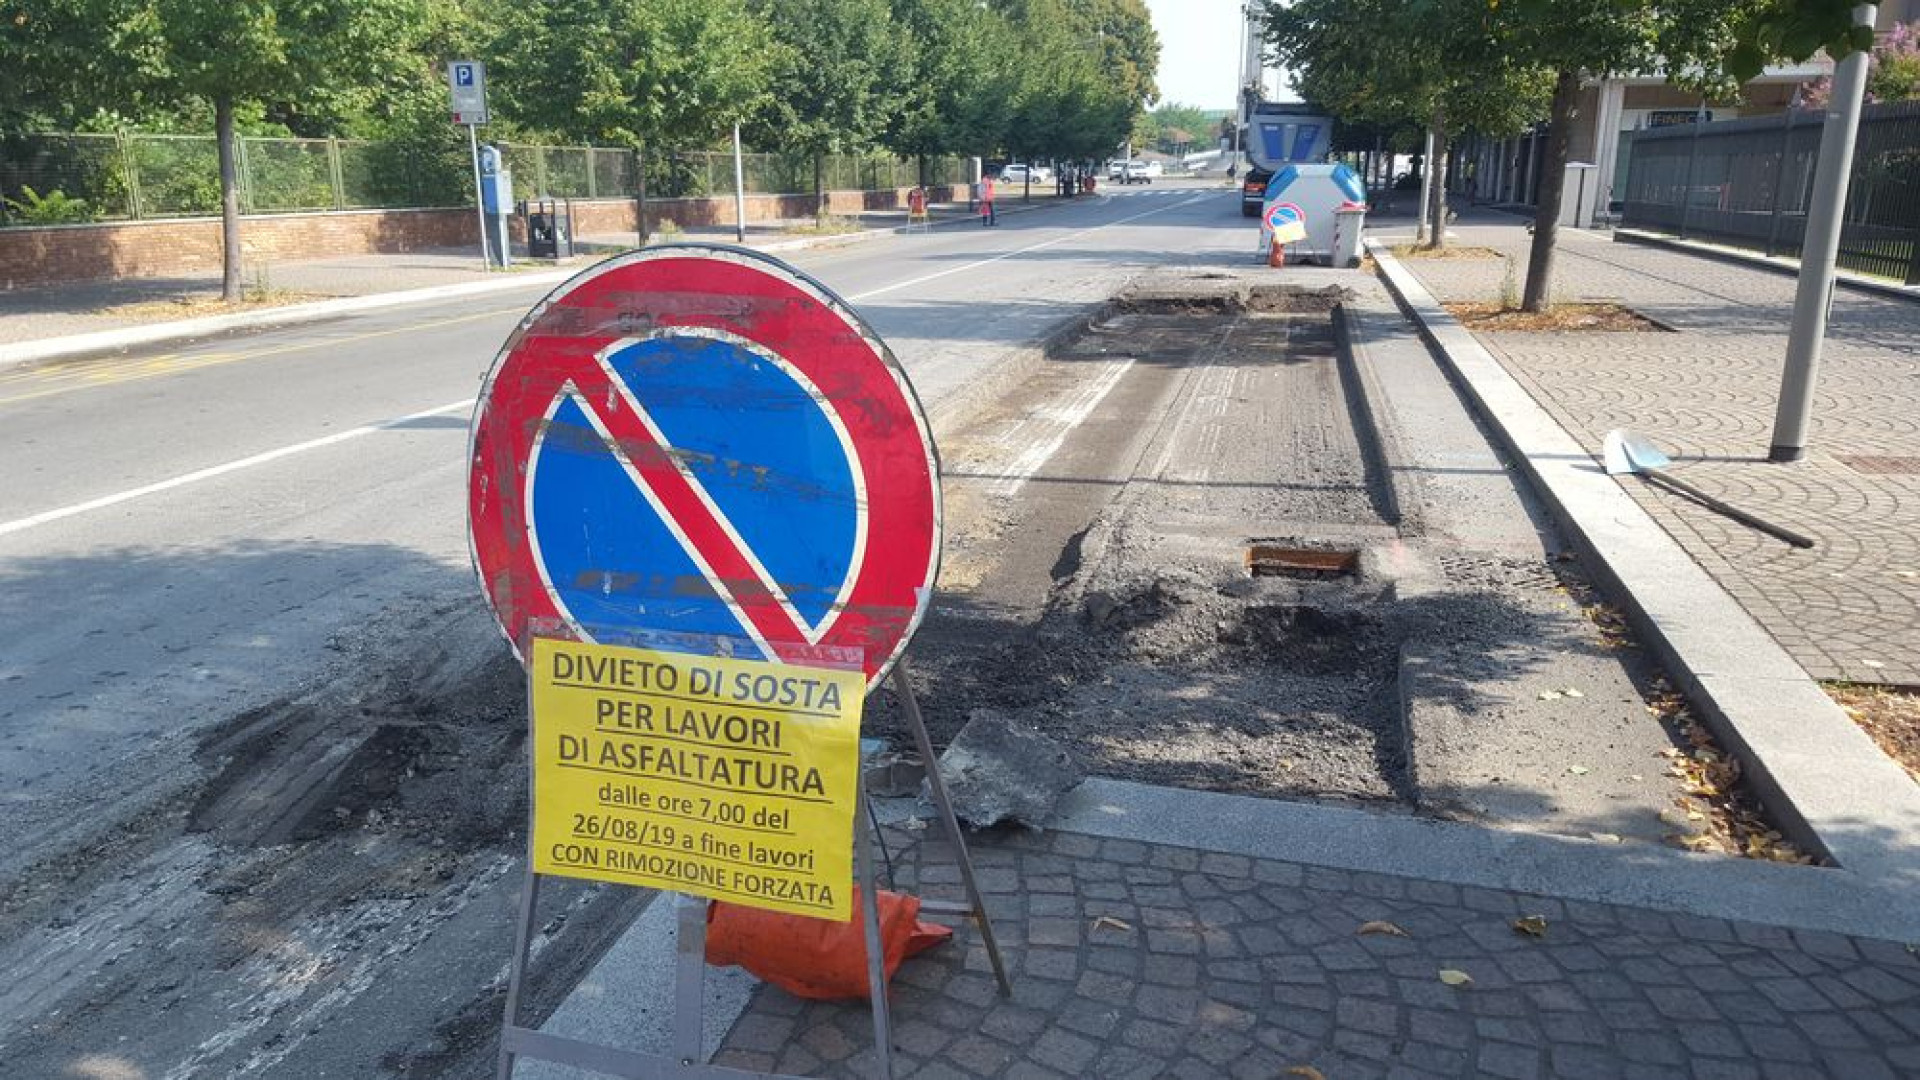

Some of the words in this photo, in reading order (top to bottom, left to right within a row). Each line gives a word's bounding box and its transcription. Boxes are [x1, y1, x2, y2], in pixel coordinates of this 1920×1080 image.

[458, 68, 469, 85] P
[553, 651, 679, 691] DIVIETO
[689, 666, 723, 699] DI
[732, 672, 842, 711] SOSTA
[596, 698, 654, 731] PER
[665, 705, 781, 748] LAVORI
[559, 734, 589, 763] DI
[598, 740, 825, 795] ASFALTATURA
[598, 782, 651, 808] dalle
[658, 795, 694, 814] ore
[700, 797, 745, 824] 7,00
[753, 806, 790, 830] del
[573, 812, 675, 847] 26/08/19
[682, 833, 694, 849] a
[701, 831, 742, 859] fine
[748, 841, 813, 870] lavori
[552, 843, 600, 866] CON
[605, 849, 727, 888] RIMOZIONE
[733, 872, 835, 906] FORZATA
